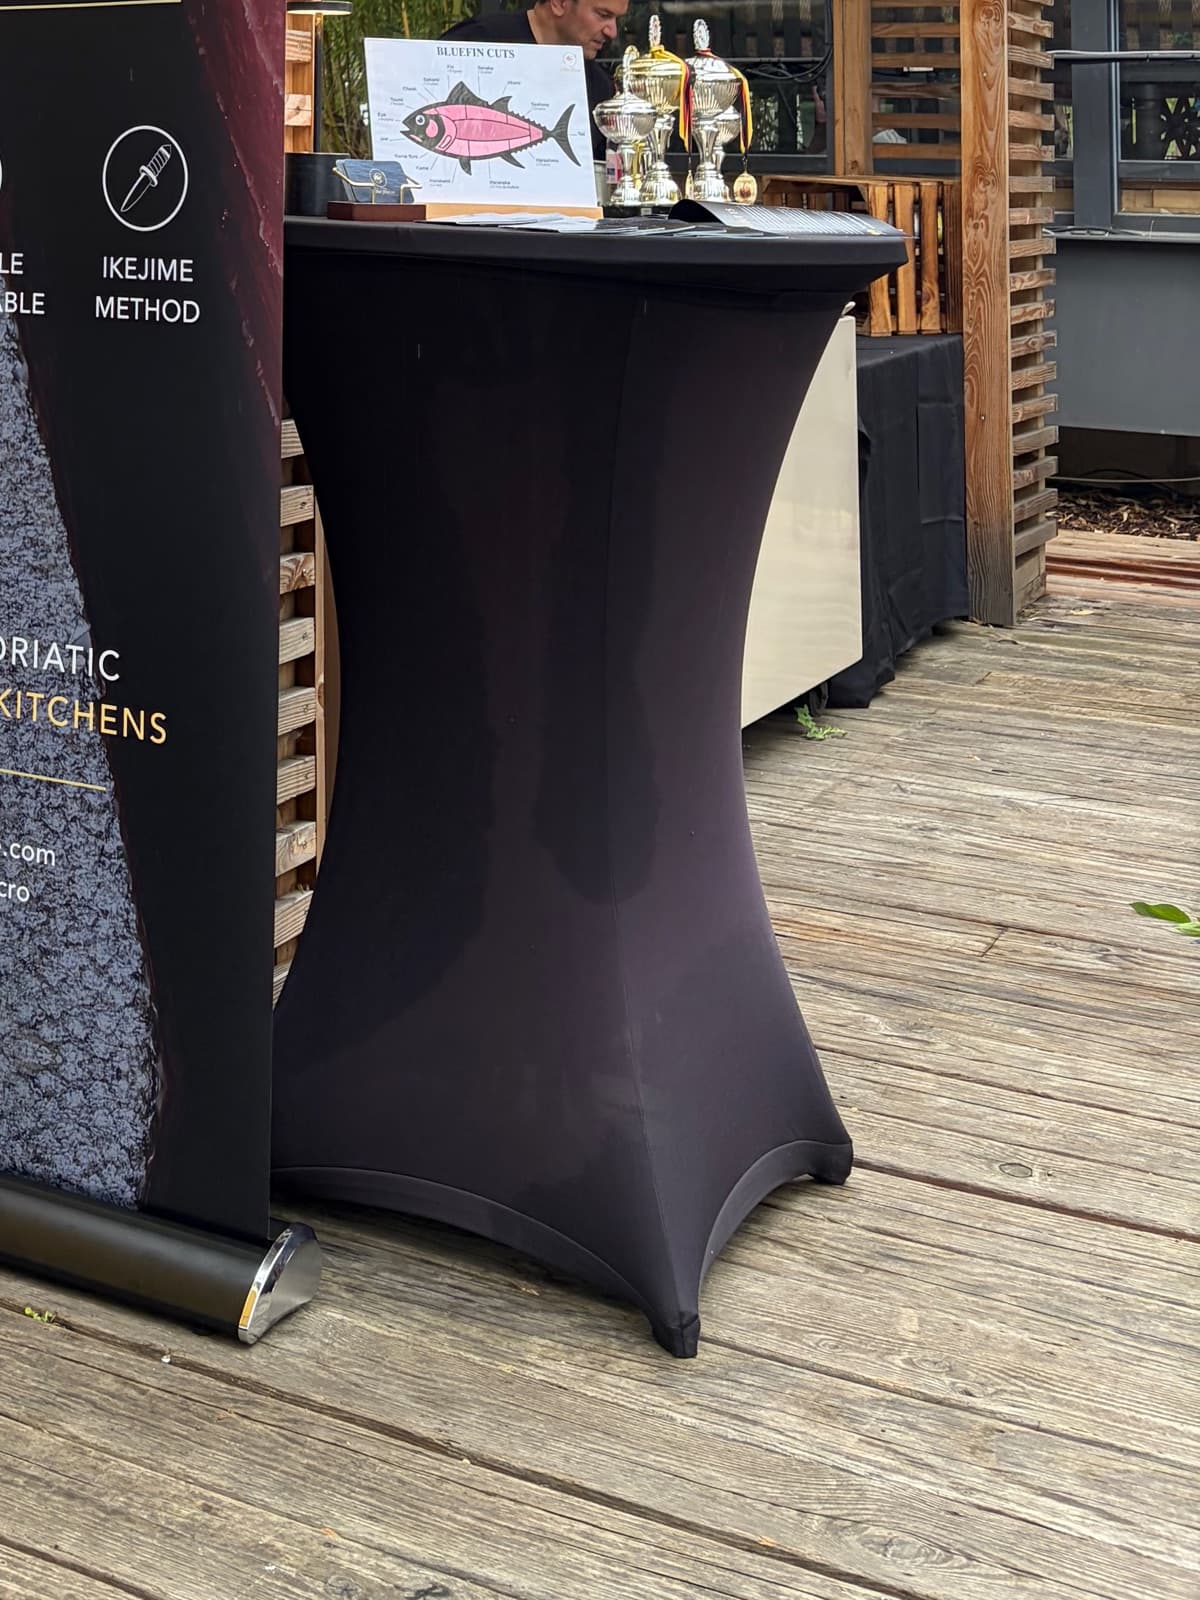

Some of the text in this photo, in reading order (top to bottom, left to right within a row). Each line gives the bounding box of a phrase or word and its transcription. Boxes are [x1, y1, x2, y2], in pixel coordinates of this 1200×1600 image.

[436, 46, 515, 59] BLUEFIN CUTS
[103, 256, 194, 283] IKEJIME
[95, 296, 200, 324] METHOD
